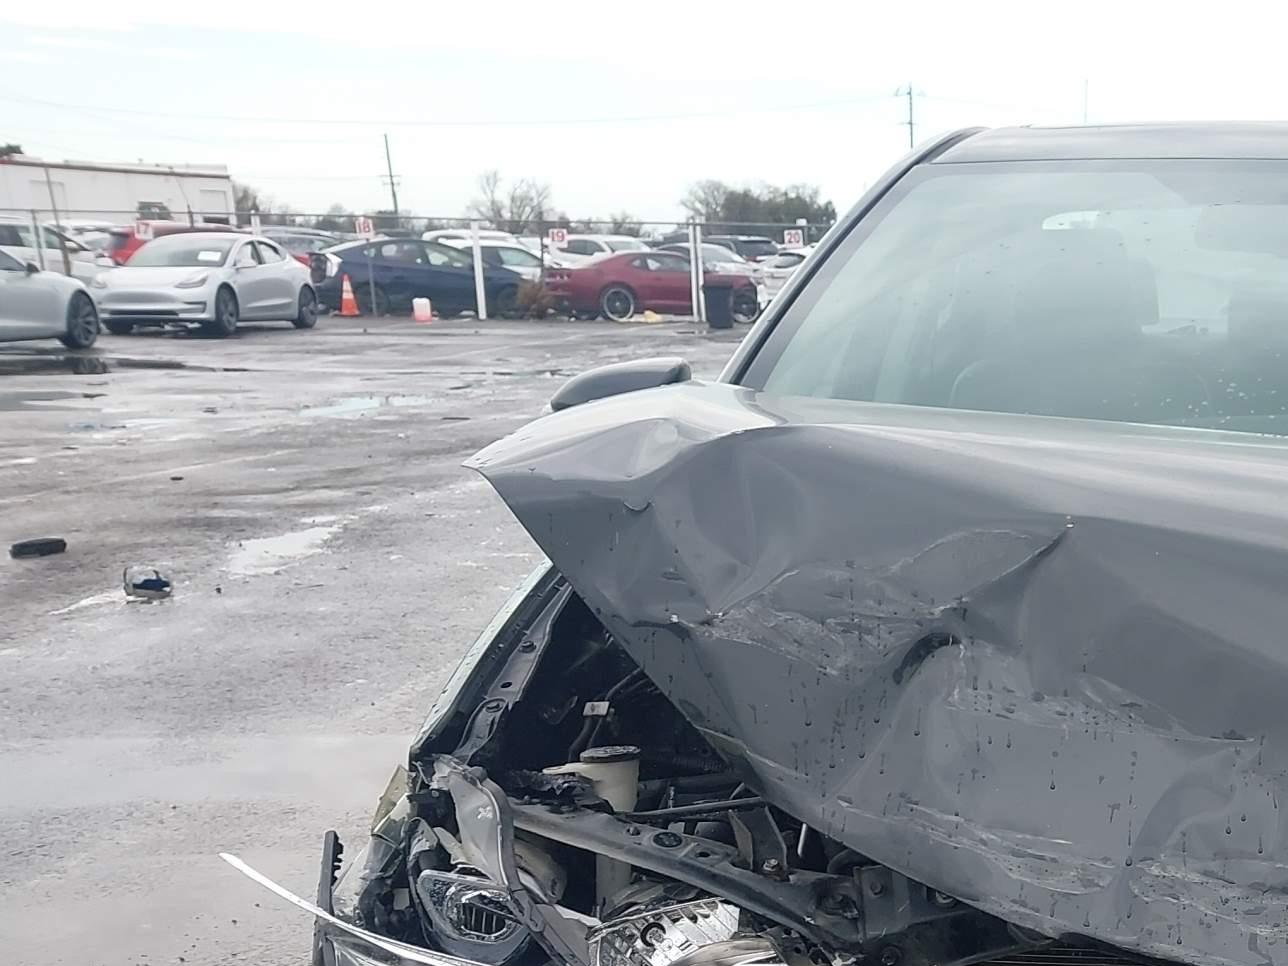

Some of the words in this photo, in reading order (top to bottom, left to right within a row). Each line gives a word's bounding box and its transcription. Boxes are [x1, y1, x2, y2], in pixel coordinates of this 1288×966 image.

[136, 223, 150, 234] 17
[357, 218, 370, 233] 18
[551, 231, 566, 242] 19
[786, 232, 800, 244] 20
